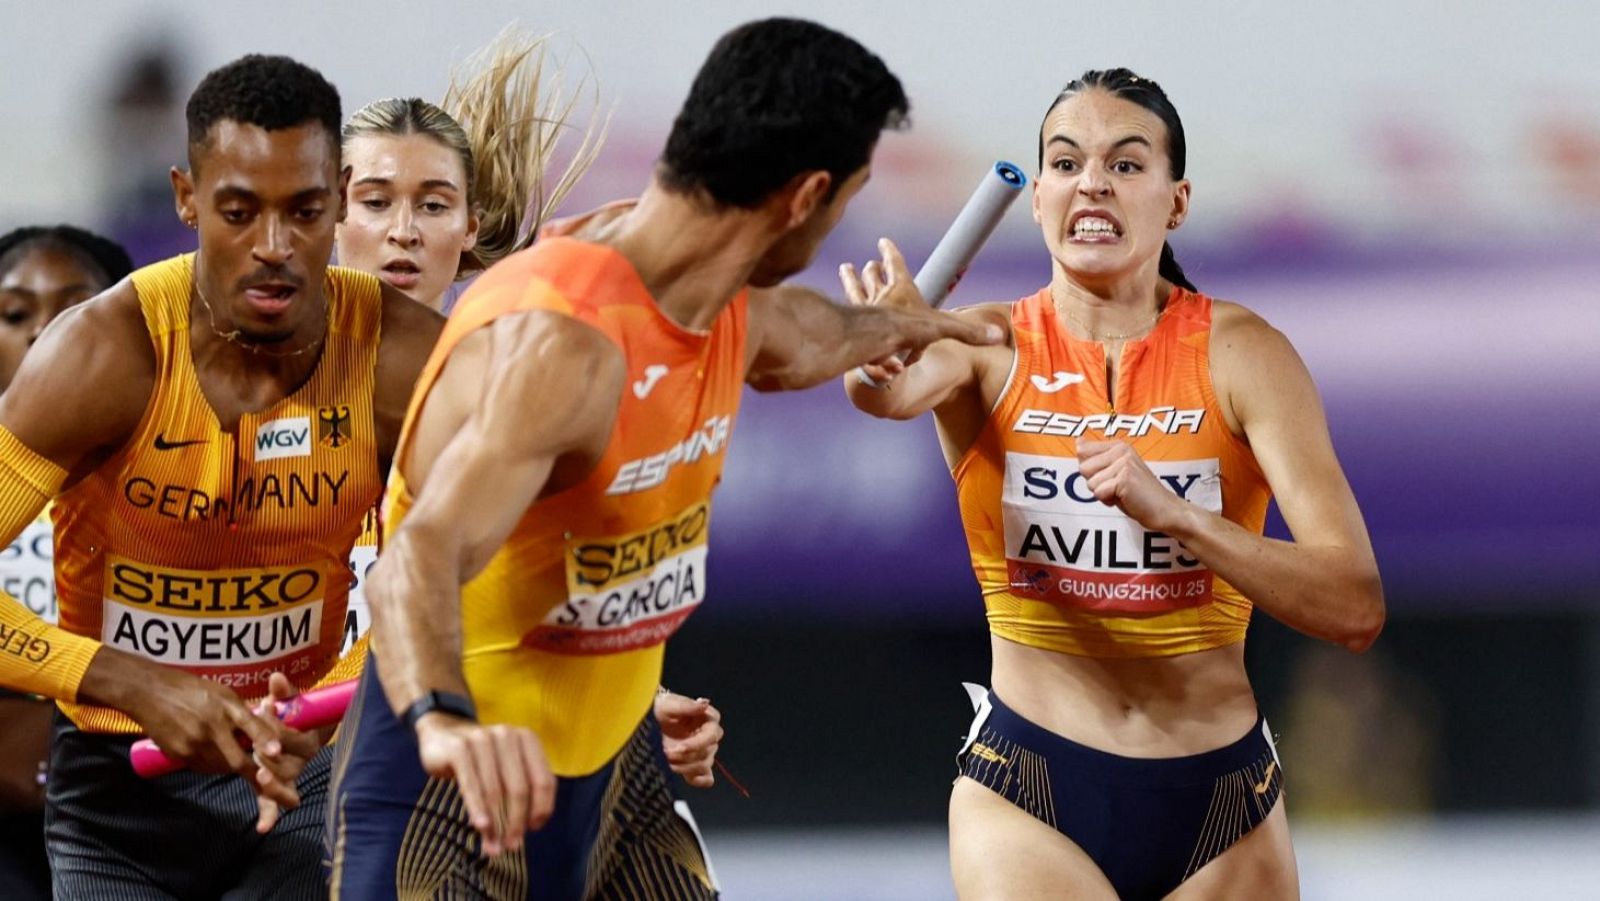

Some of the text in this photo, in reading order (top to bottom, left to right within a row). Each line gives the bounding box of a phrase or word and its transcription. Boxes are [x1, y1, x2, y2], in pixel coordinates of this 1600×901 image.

[257, 428, 308, 451] WGV
[1013, 406, 1205, 437] ESPAÑA
[124, 470, 348, 521] GERMANY
[1024, 467, 1201, 503] SOY
[113, 564, 319, 611] SEIKO
[1058, 578, 1205, 600] GUANGZHOU 25
[113, 608, 312, 659] AGYEKUM
